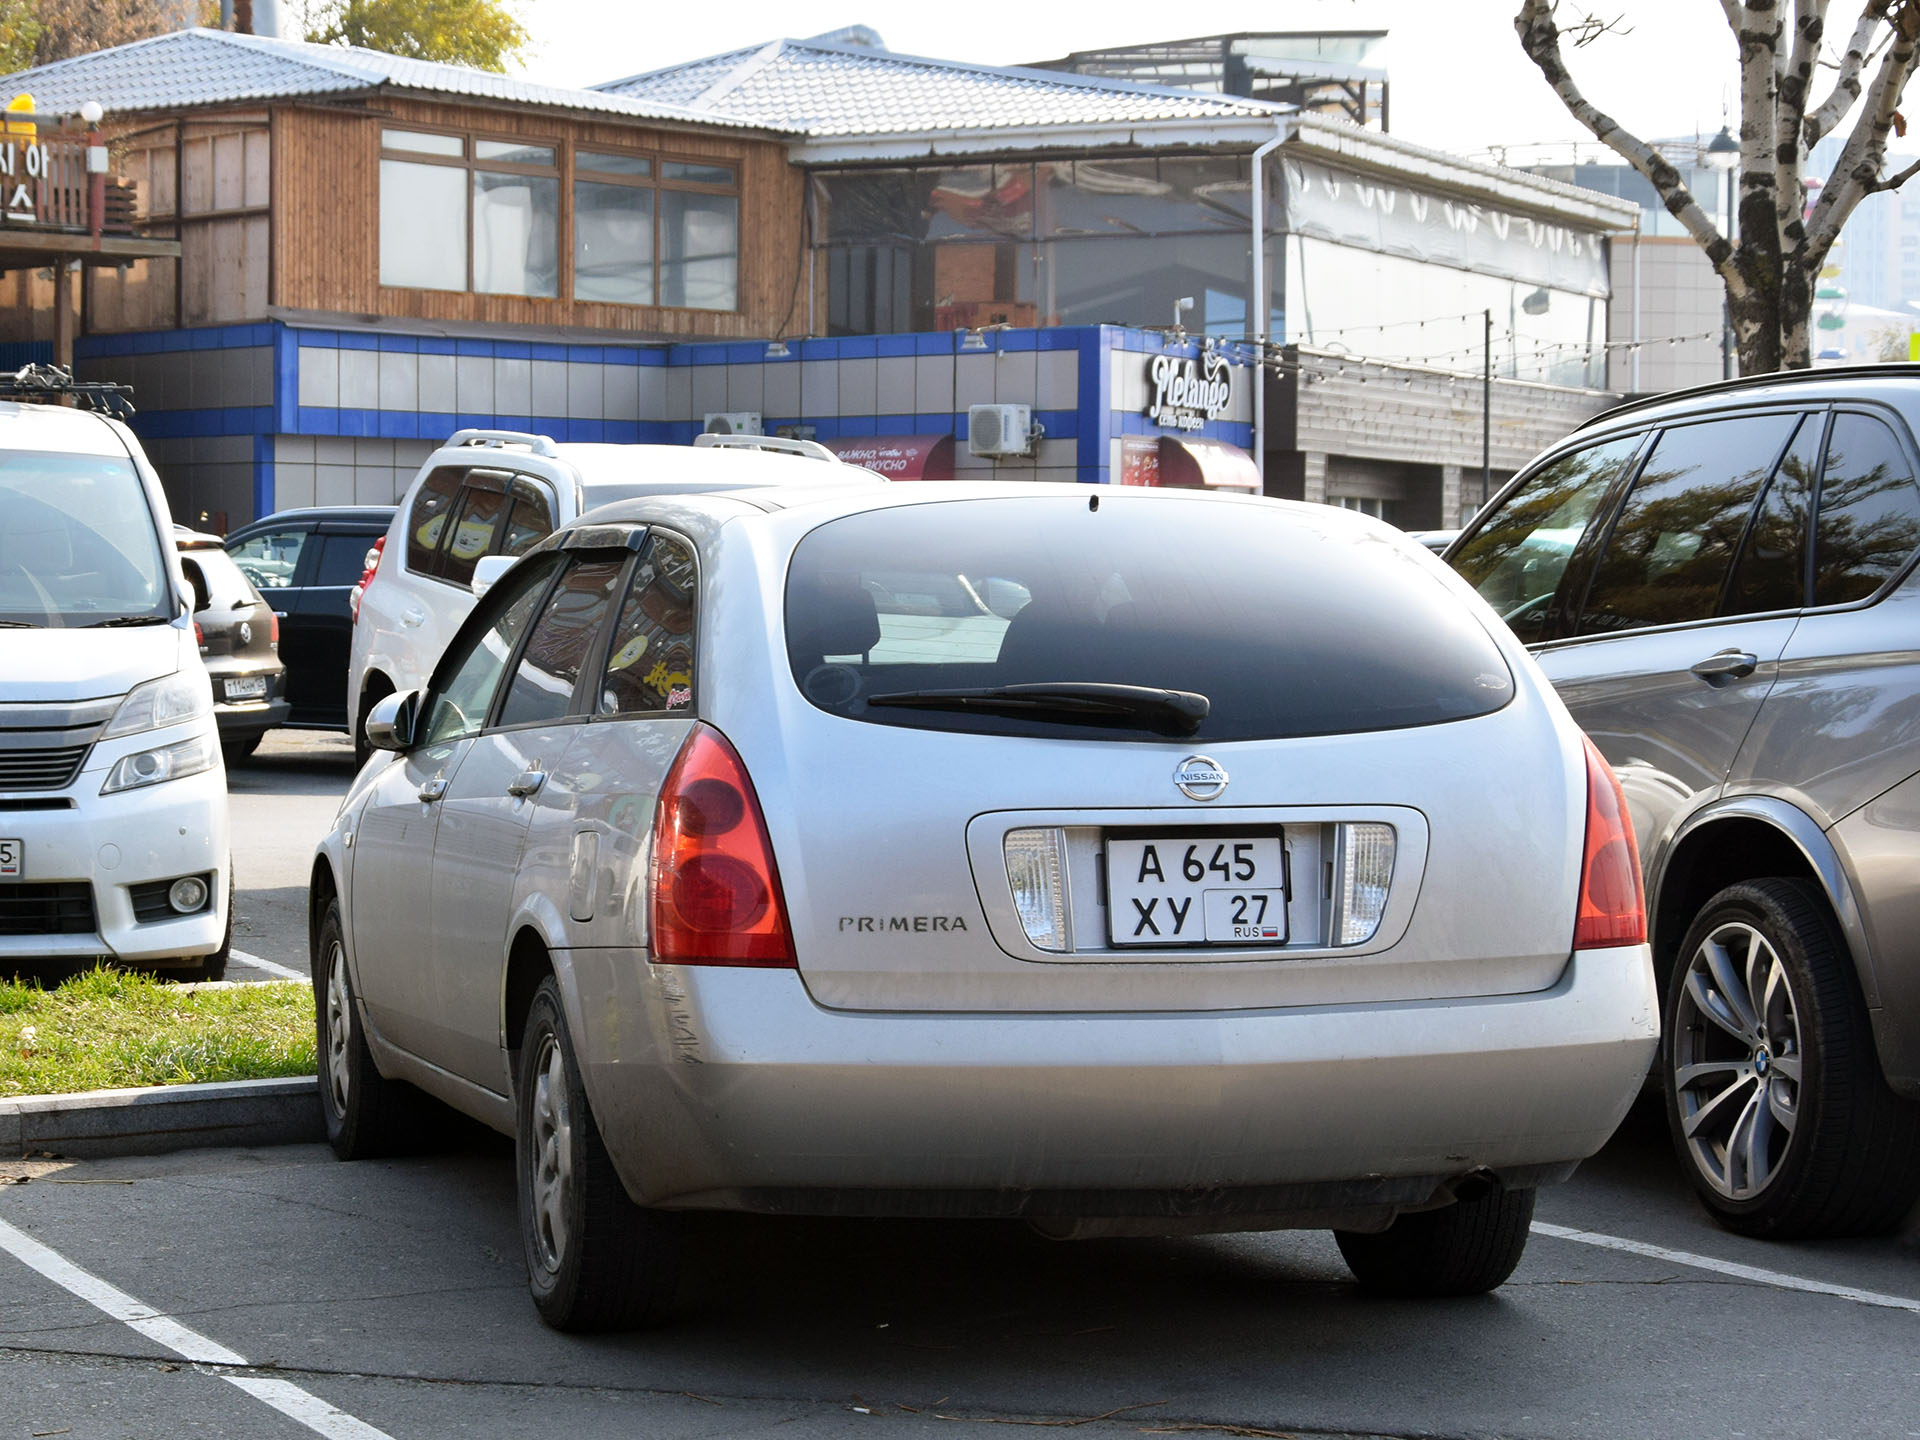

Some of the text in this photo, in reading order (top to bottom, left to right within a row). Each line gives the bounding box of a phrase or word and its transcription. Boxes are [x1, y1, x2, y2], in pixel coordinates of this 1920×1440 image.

[864, 460, 907, 471] ВКУСНО
[1181, 773, 1224, 781] NISSAN
[1138, 844, 1256, 882] А 645
[1231, 895, 1268, 924] 27
[1234, 927, 1259, 937] RUS
